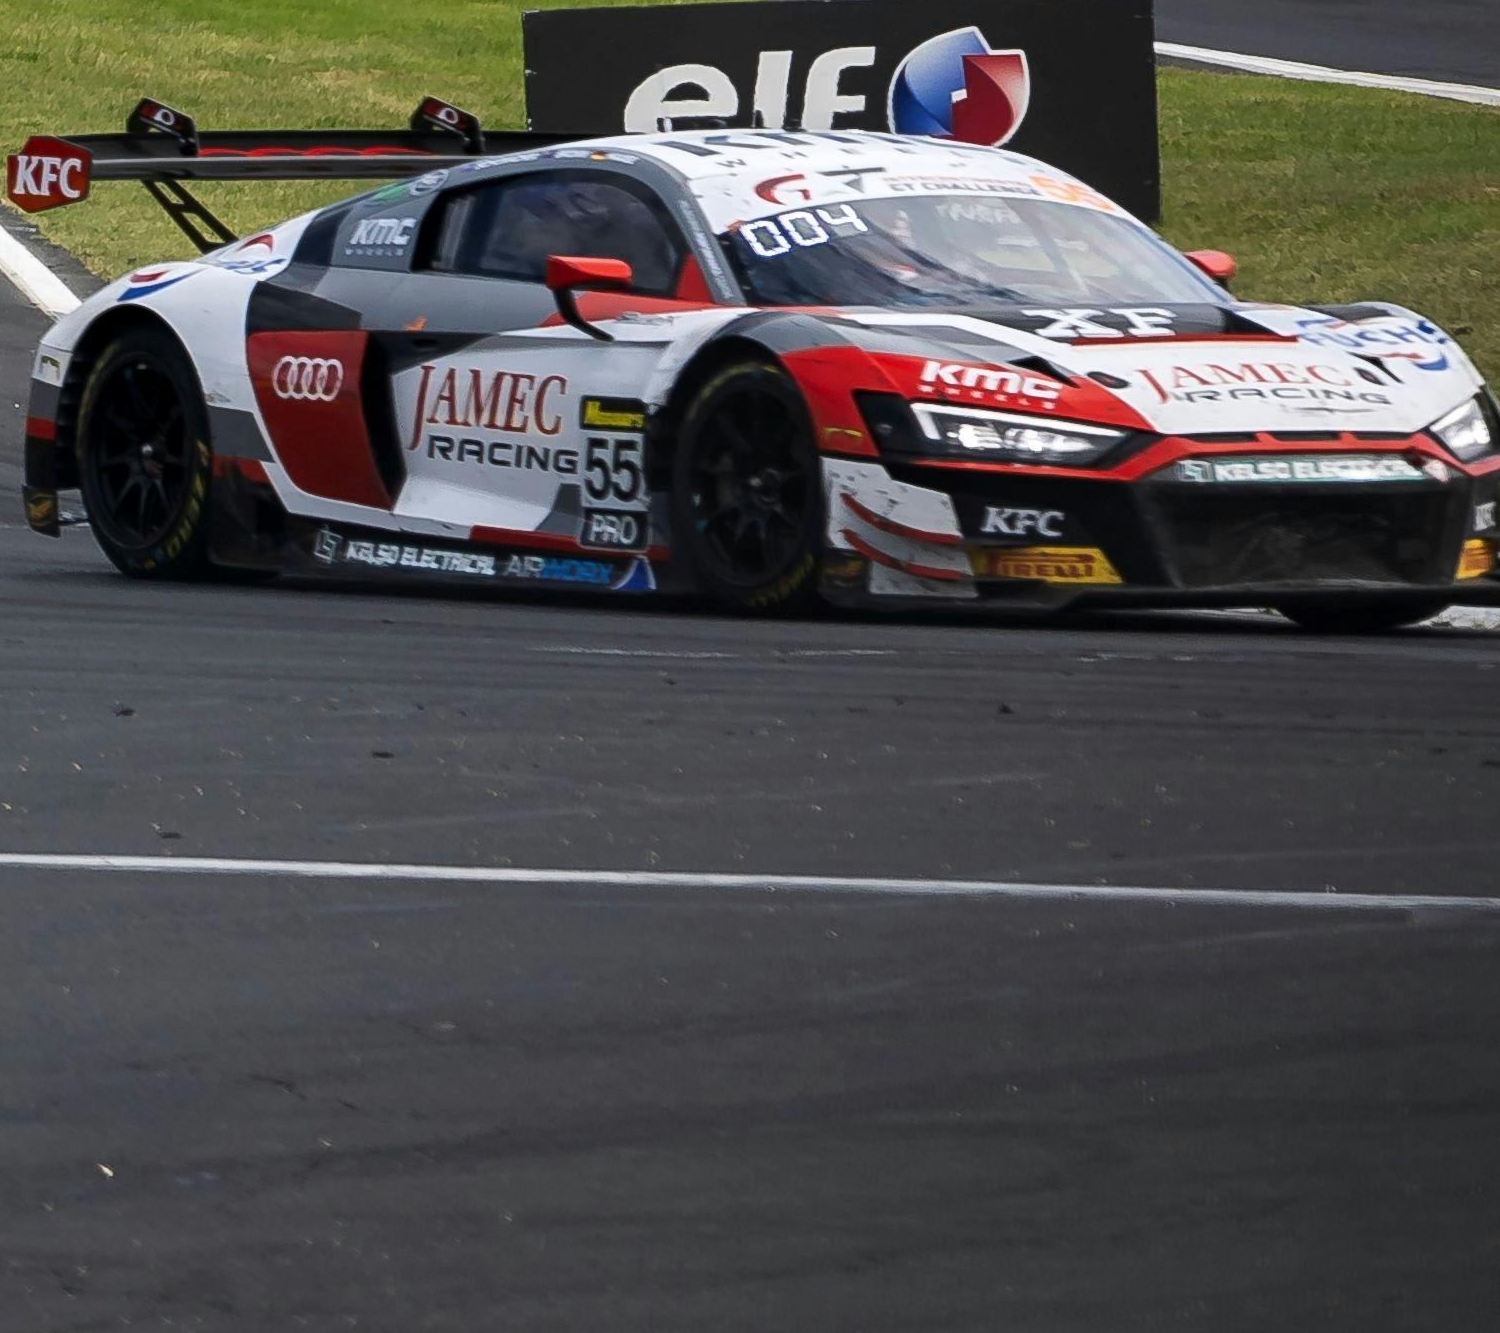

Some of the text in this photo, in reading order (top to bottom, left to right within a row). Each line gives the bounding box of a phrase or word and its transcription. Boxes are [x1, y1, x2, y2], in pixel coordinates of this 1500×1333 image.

[625, 46, 876, 132] elf
[12, 155, 83, 200] KFC
[738, 203, 867, 259] 004
[1136, 362, 1351, 404] JAMEC
[1175, 387, 1393, 405] RACING
[409, 364, 568, 452] JAMEC
[427, 435, 580, 475] RACING
[584, 437, 643, 501] 55
[587, 513, 638, 544] PRO
[979, 505, 1066, 537] KFC
[400, 546, 497, 576] ELECTRICAL
